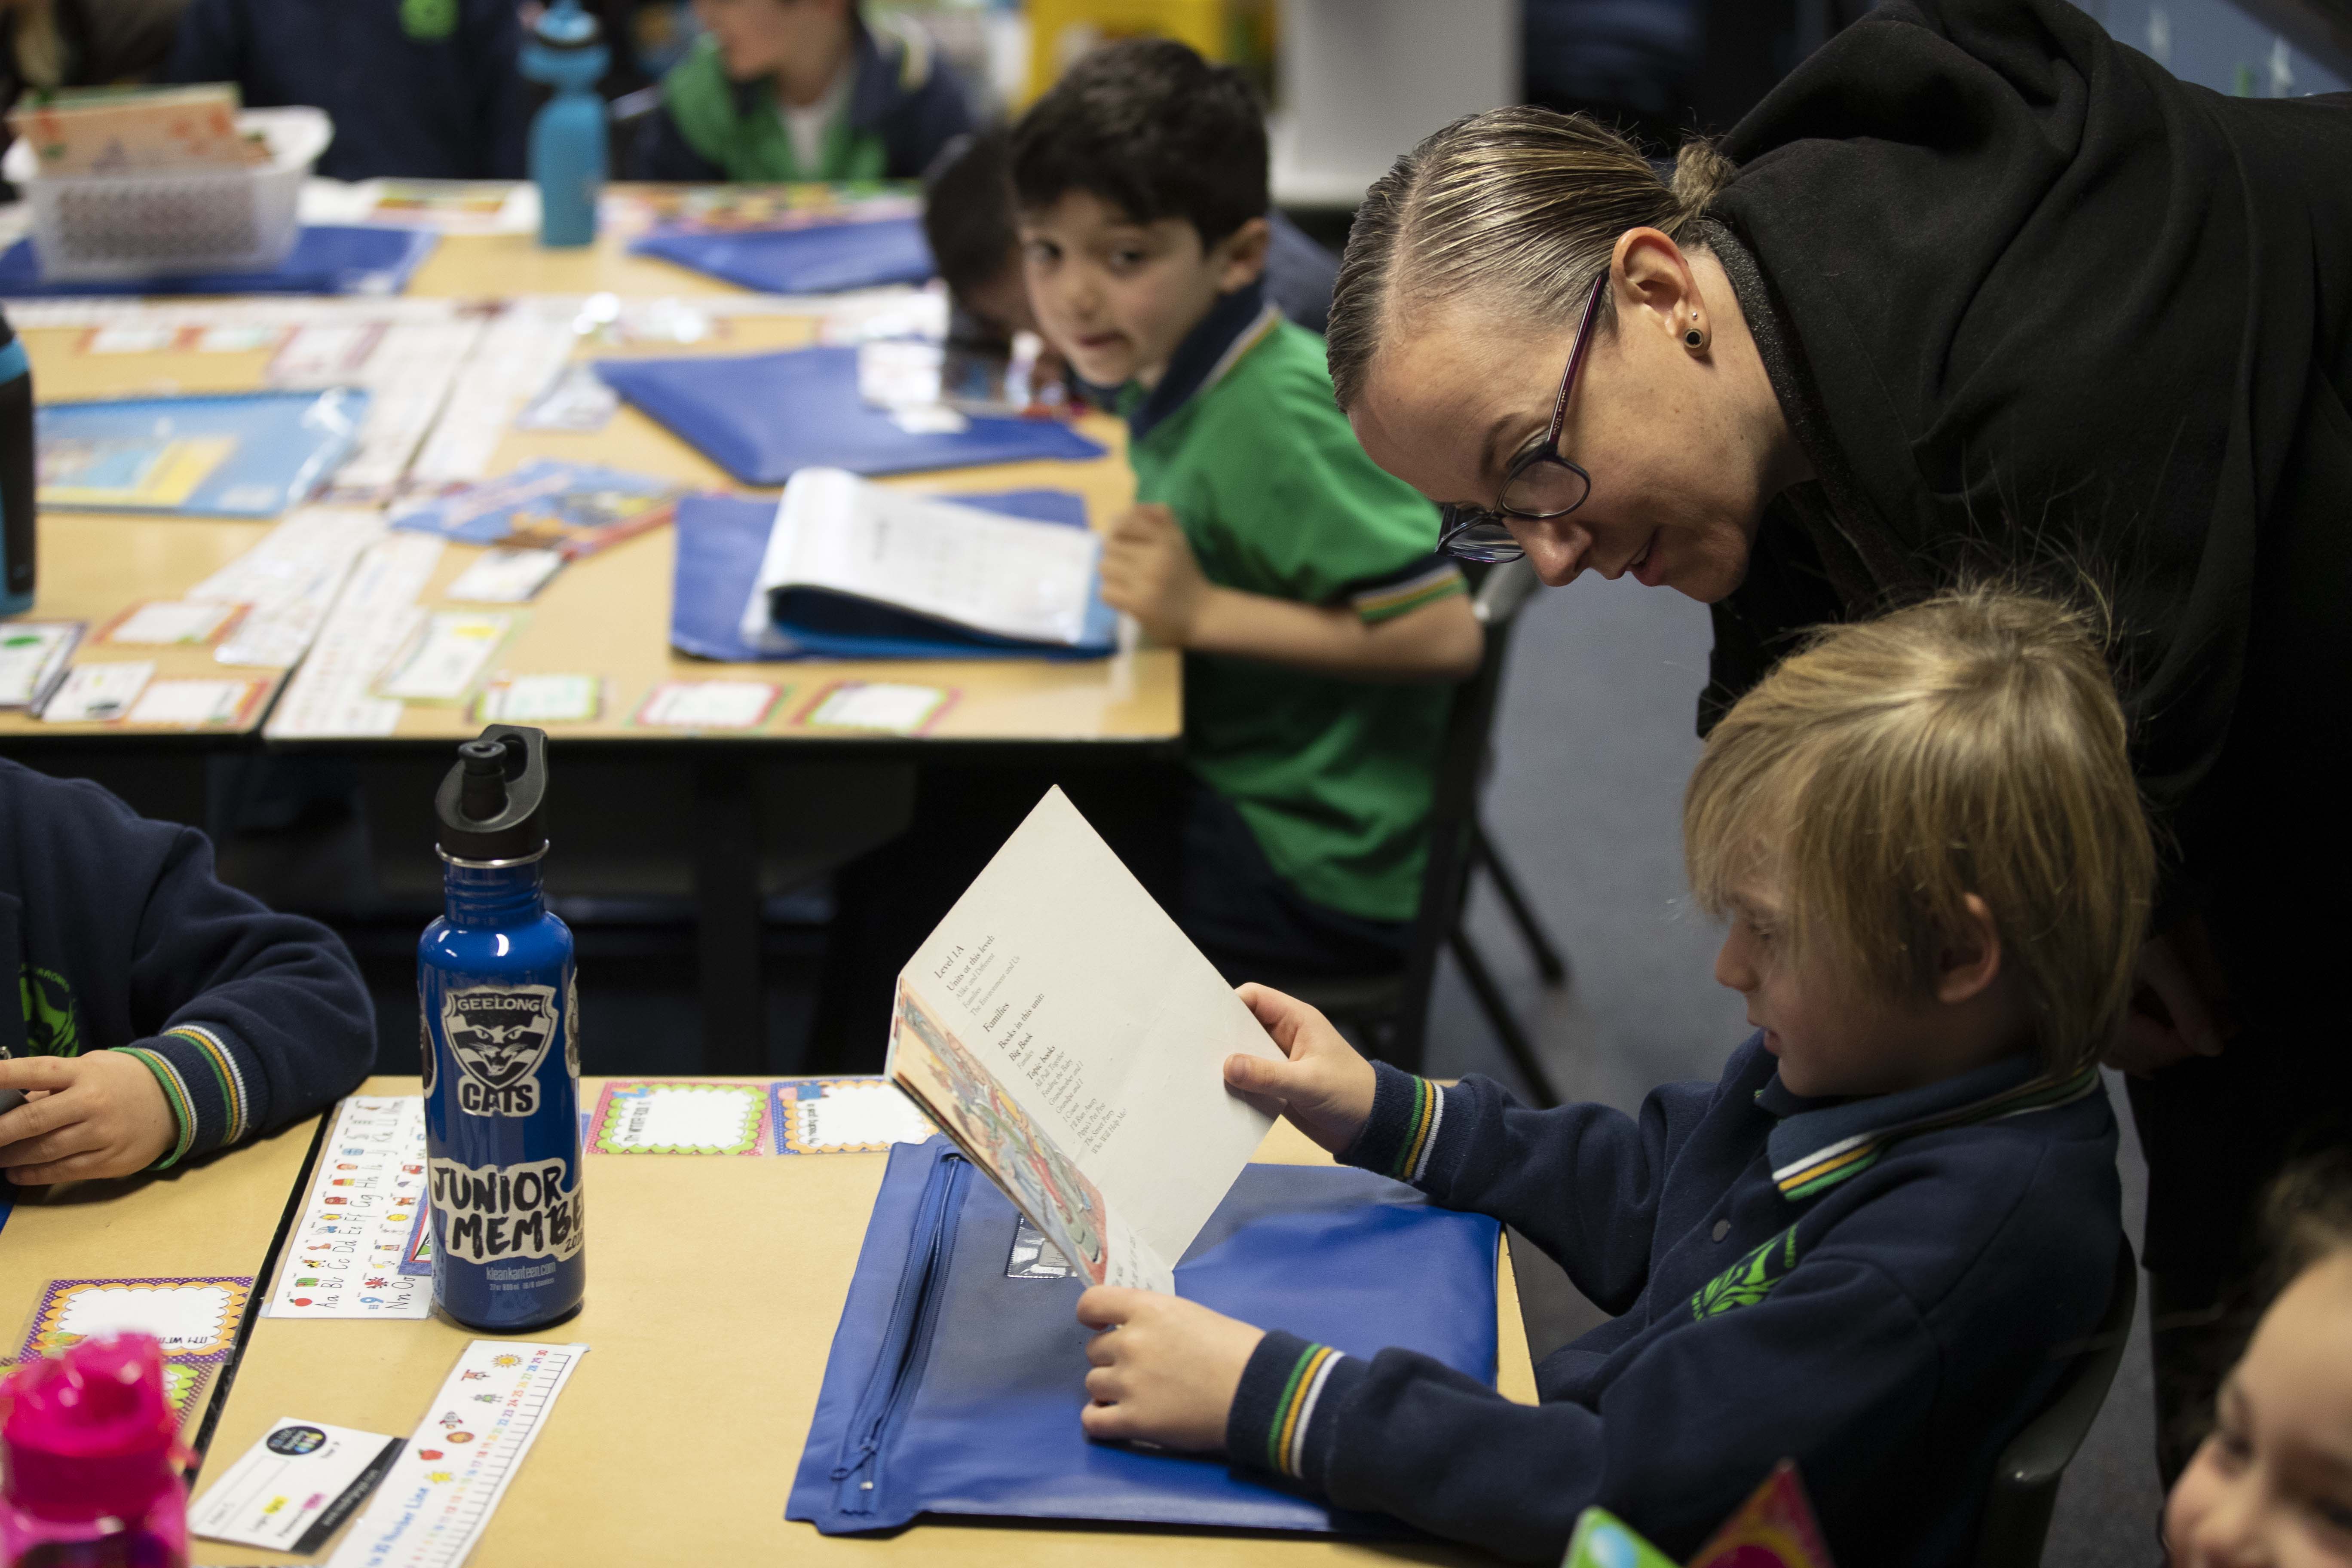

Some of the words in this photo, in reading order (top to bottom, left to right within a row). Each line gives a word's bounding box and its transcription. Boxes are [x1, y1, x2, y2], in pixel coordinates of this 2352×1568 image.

[934, 956, 954, 978] Level
[952, 946, 964, 958] 1A
[946, 974, 964, 991] Units
[963, 965, 971, 974] at
[969, 953, 980, 965] this
[978, 936, 995, 953] level:
[956, 986, 969, 1000] Alike
[968, 973, 978, 986] and
[974, 953, 995, 975] Different
[970, 1005, 981, 1016] The
[979, 974, 1006, 1006] Environment
[1005, 962, 1015, 974] and
[1011, 956, 1020, 964] Us
[962, 987, 982, 1008] Families
[458, 998, 541, 1012] GEELONG
[983, 1004, 1009, 1032] Families
[998, 1030, 1016, 1049] Books
[1021, 1009, 1032, 1022] this
[1031, 993, 1044, 1009] unit:
[1009, 1049, 1021, 1061] Big
[1018, 1033, 1033, 1050] Book
[1017, 1050, 1034, 1070] Families
[1026, 1063, 1042, 1080] Topic
[1040, 1045, 1055, 1063] books
[462, 1083, 533, 1113] CATS
[355, 1176, 379, 1188] Hh
[434, 1166, 562, 1215] JUNIOR
[350, 1194, 383, 1207] Gg
[344, 1213, 378, 1222] Ff
[339, 1226, 362, 1235] Ee
[332, 1240, 357, 1253] Dd
[327, 1259, 350, 1269] Cc
[486, 1262, 556, 1280] kleankanteen.com
[321, 1277, 344, 1289] Bb
[392, 1276, 416, 1289] Oo
[315, 1295, 339, 1308] Aa
[385, 1293, 411, 1309] Nn
[521, 1372, 533, 1381] 27
[517, 1381, 529, 1389] 26
[512, 1389, 524, 1398] 25
[507, 1398, 520, 1407] 24
[502, 1409, 515, 1418] 23
[496, 1418, 510, 1427] 22
[405, 1487, 429, 1509] Line
